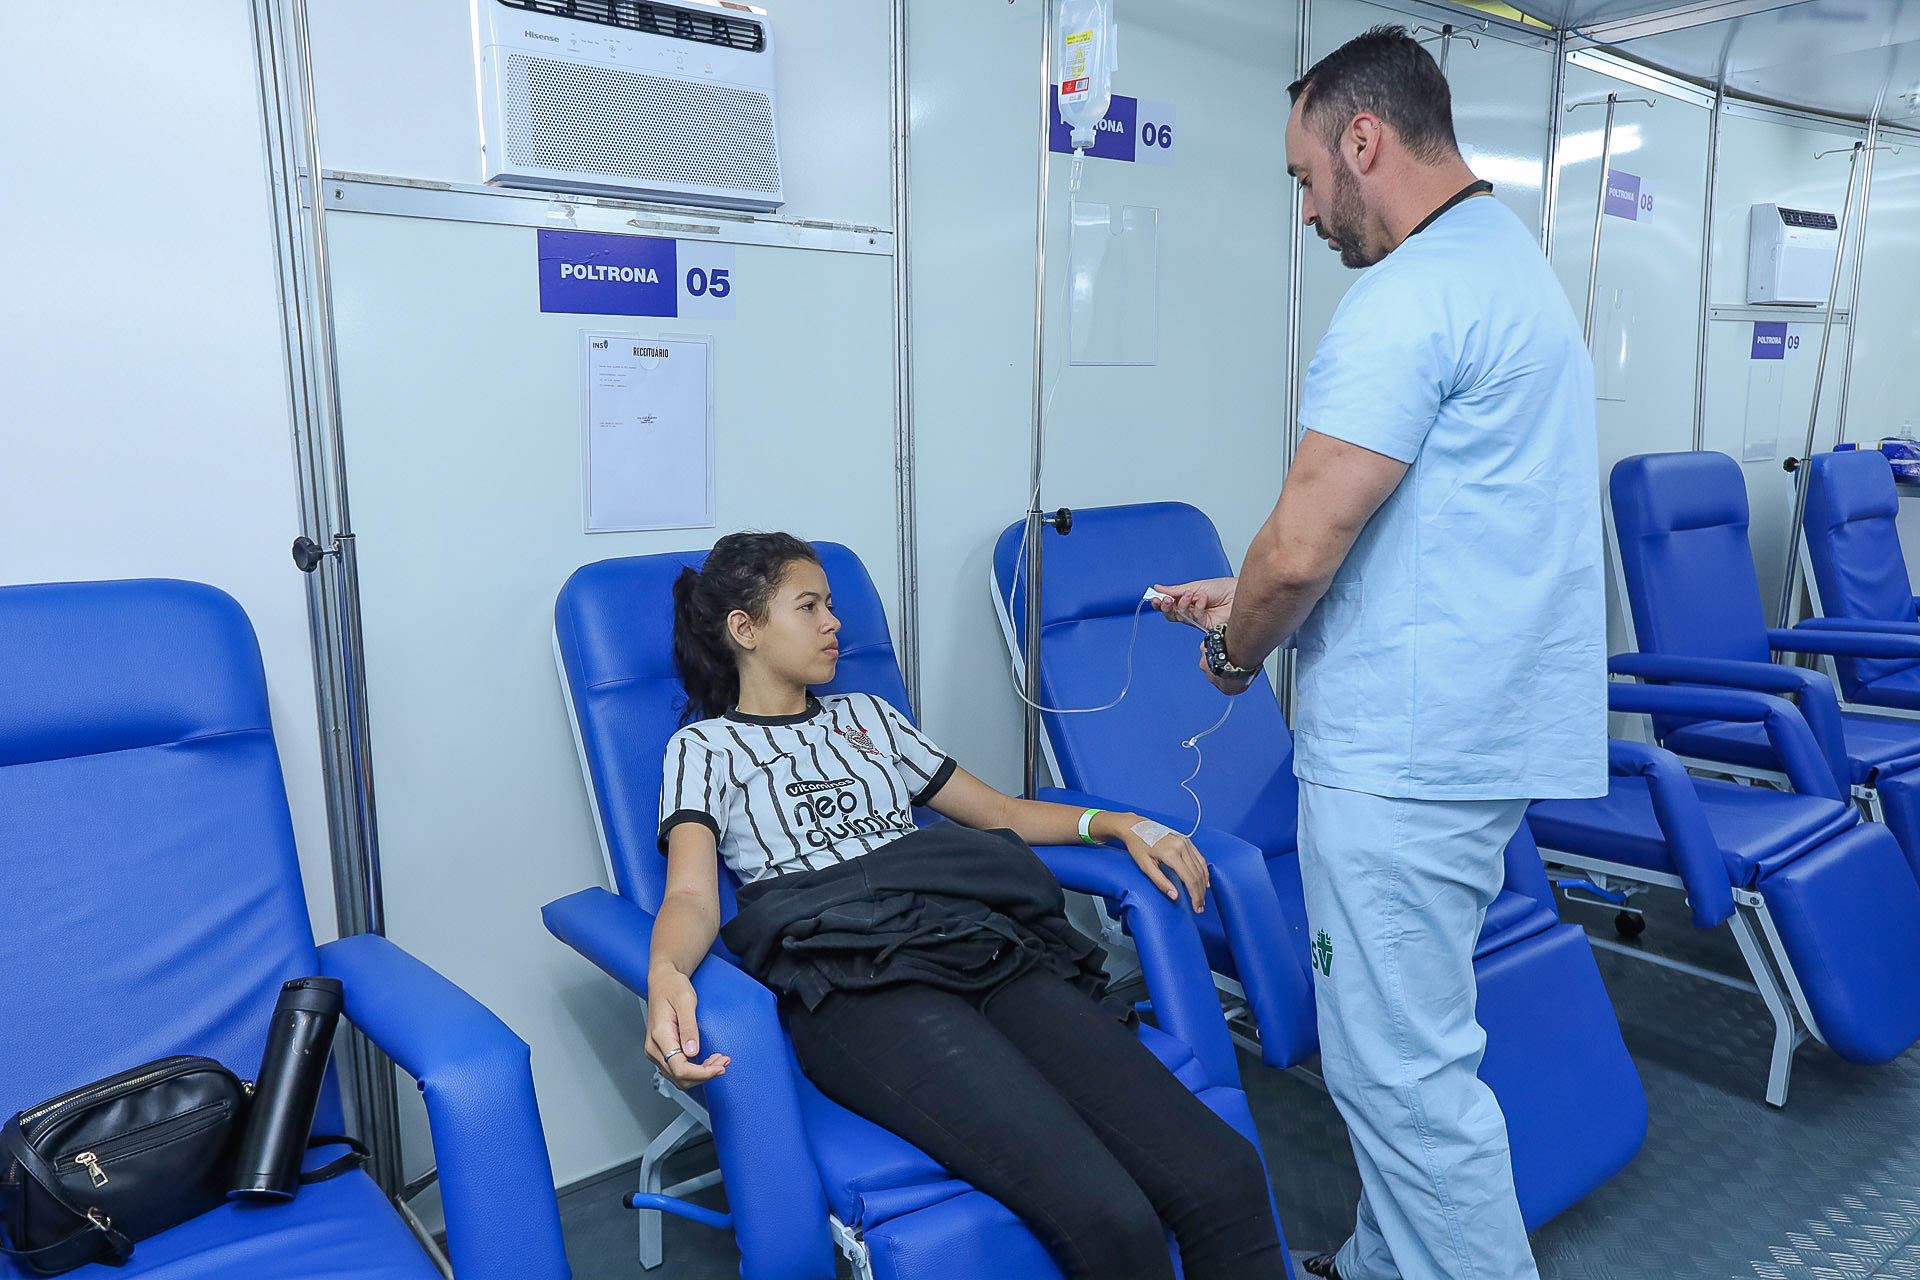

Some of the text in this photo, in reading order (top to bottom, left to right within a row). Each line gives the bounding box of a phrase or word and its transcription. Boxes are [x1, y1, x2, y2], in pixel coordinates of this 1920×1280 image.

[524, 29, 560, 43] Hisense
[1142, 122, 1172, 149] 06
[1608, 186, 1653, 212] POLTRONA 08
[560, 263, 731, 298] POLTRONA 05
[1756, 335, 1800, 350] POLTRONA 09
[788, 779, 854, 796] vitaminas
[793, 791, 858, 827] neo
